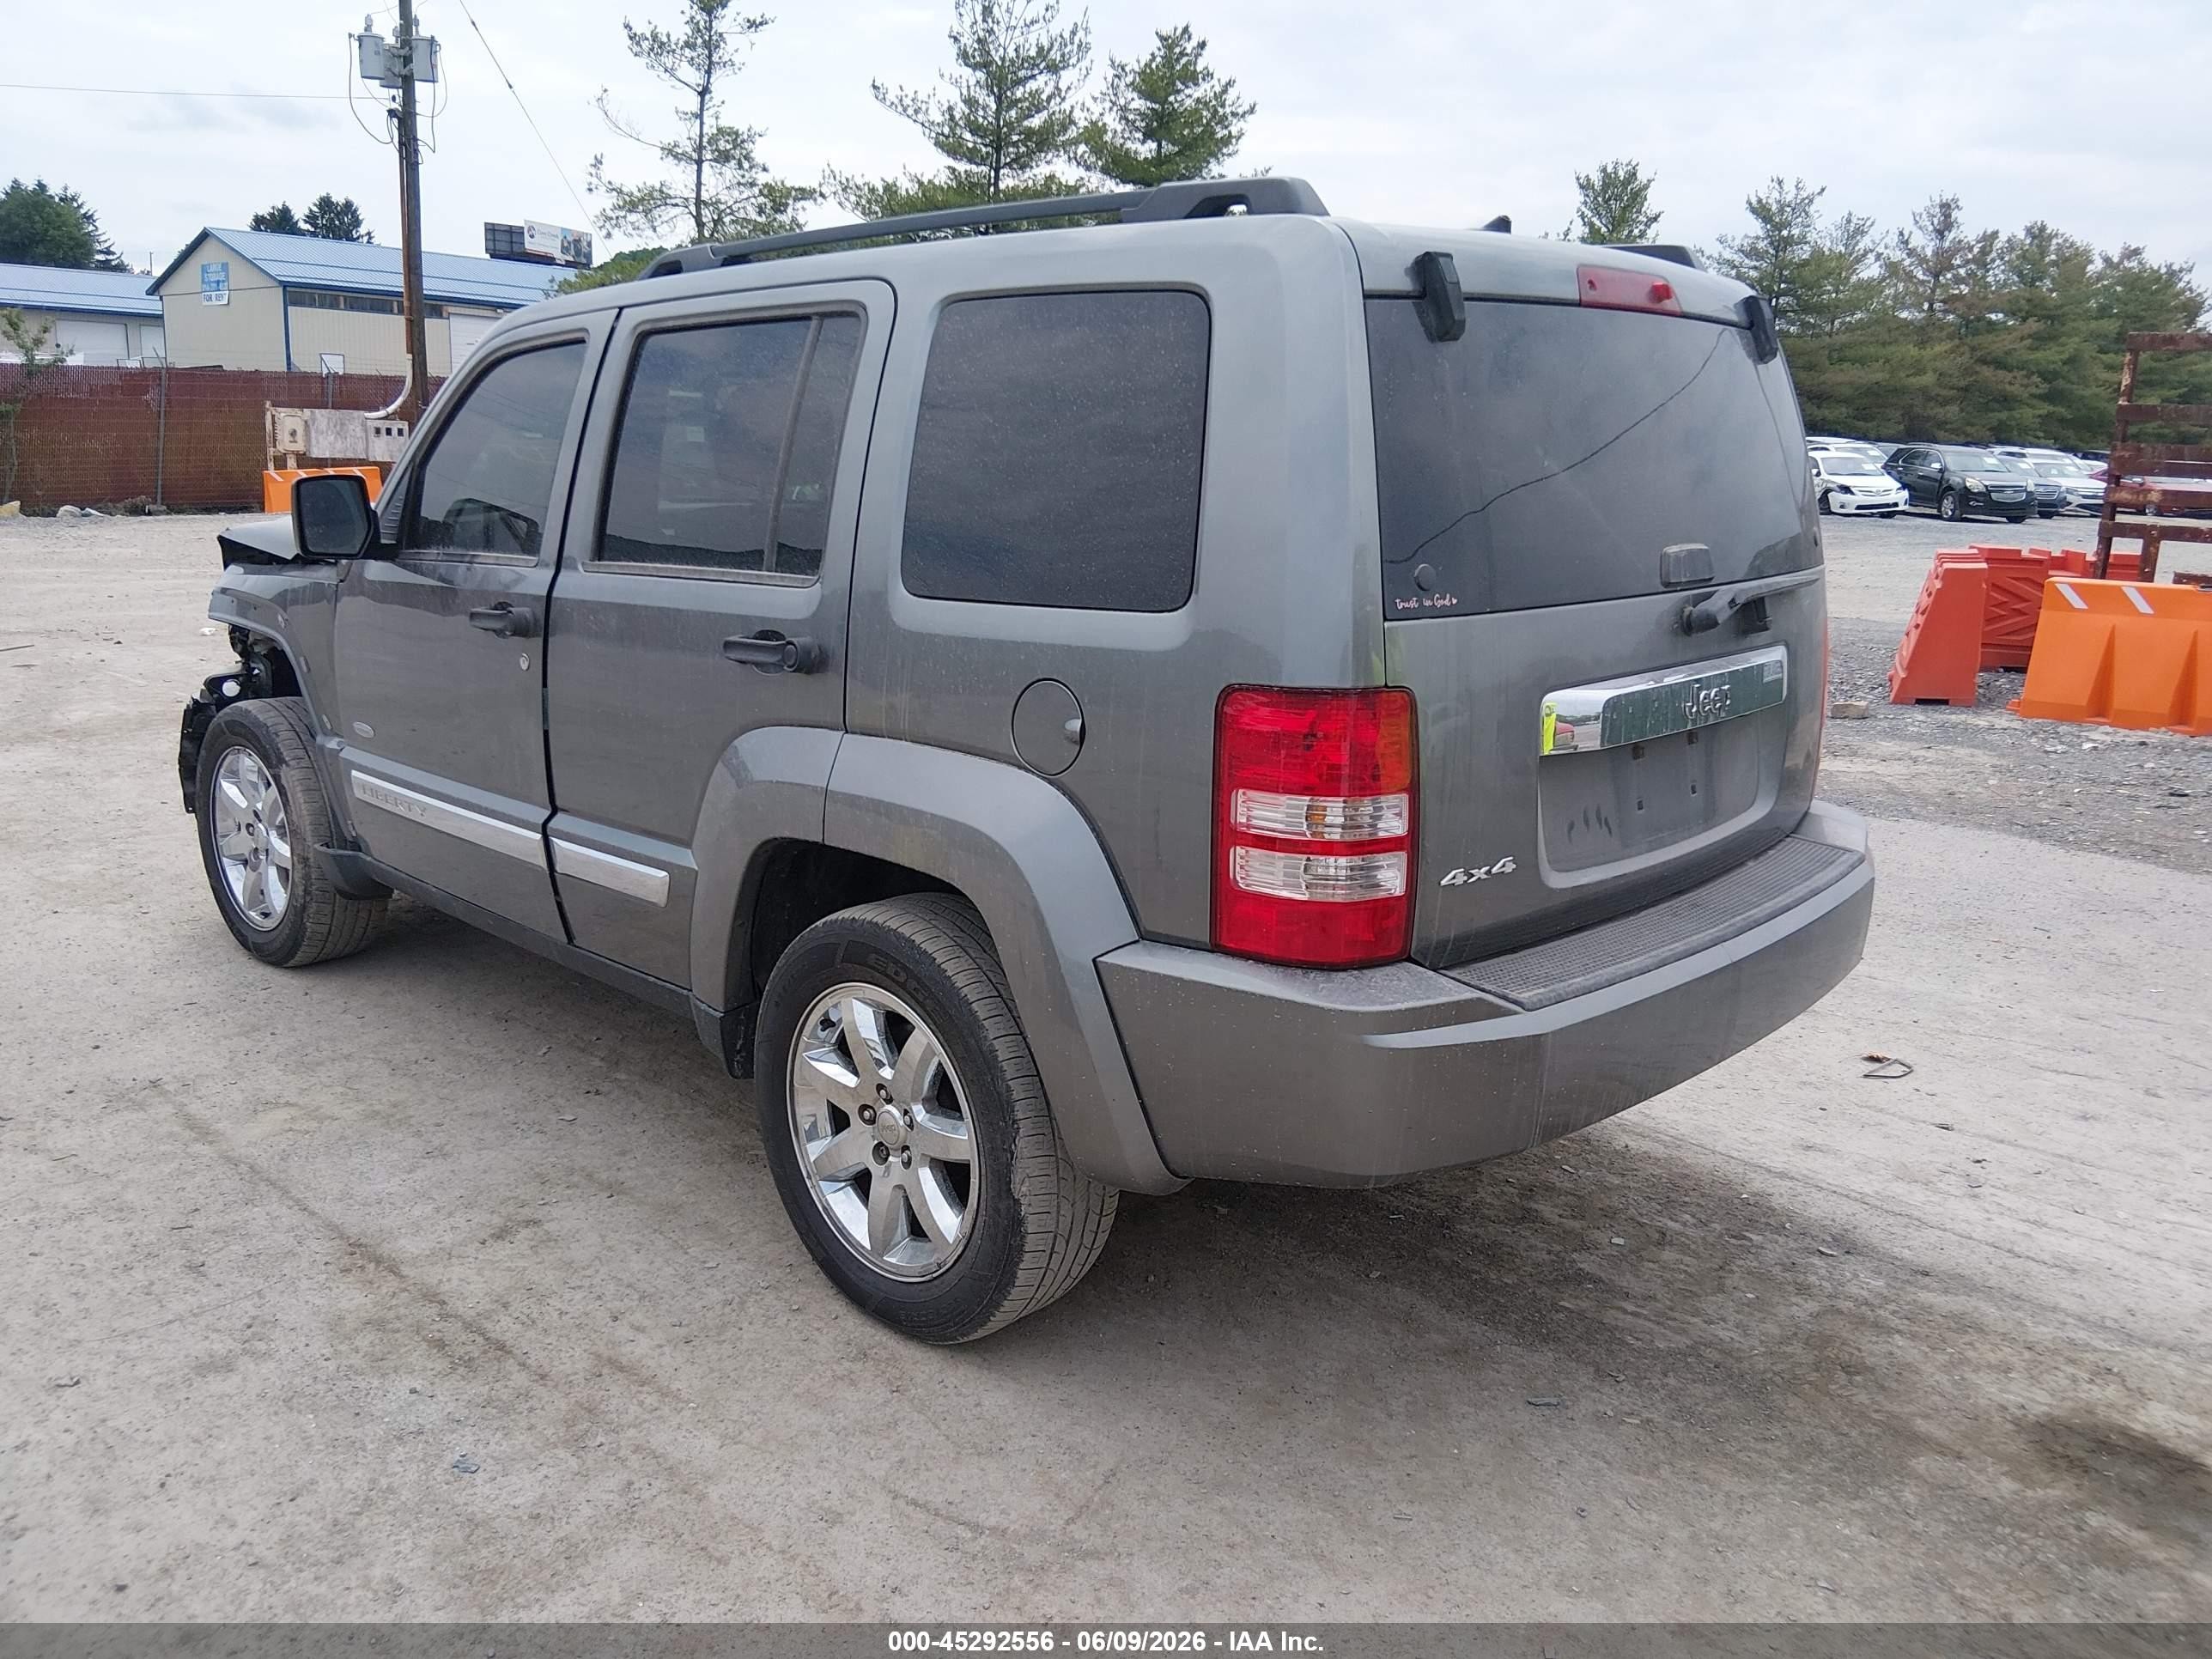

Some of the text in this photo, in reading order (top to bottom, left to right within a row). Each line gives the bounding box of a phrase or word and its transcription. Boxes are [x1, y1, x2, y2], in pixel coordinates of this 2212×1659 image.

[203, 294, 213, 302] FOR
[1433, 593, 1451, 608] God
[1681, 684, 1731, 719] Jeep
[362, 783, 427, 817] LIBERTY
